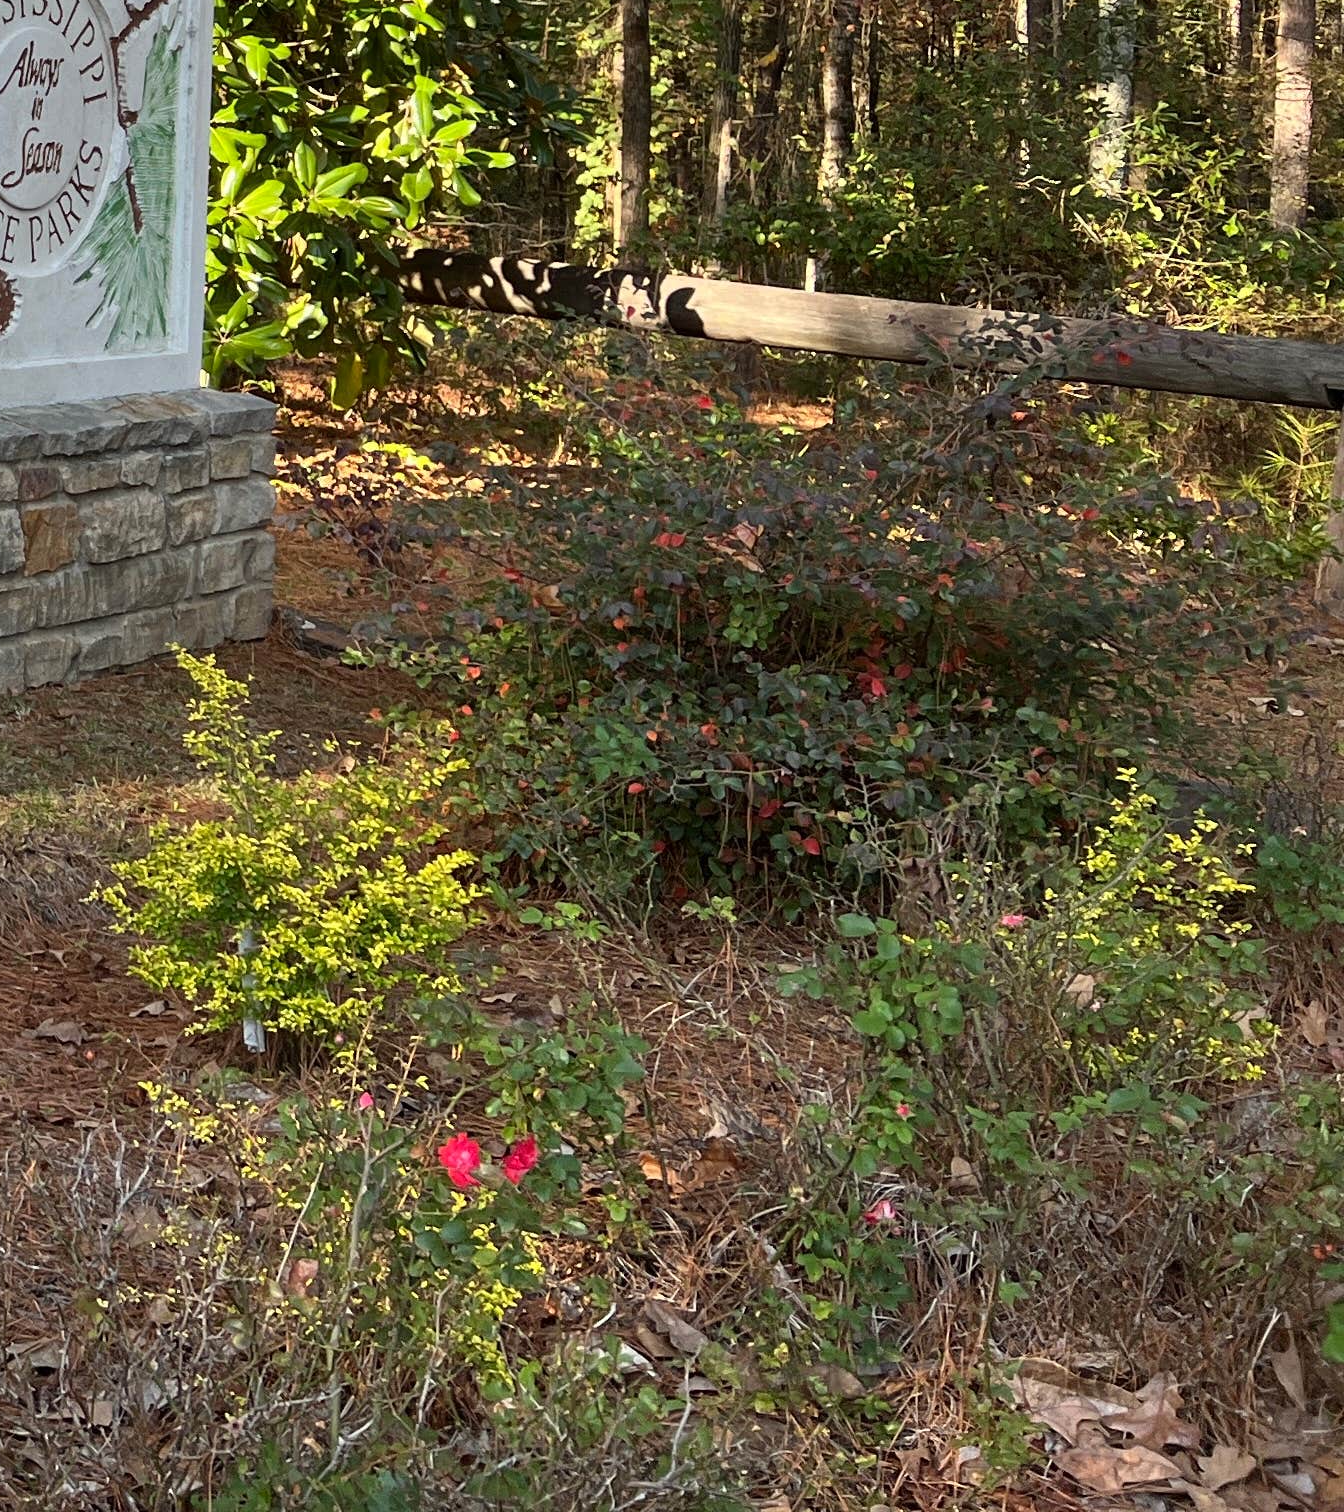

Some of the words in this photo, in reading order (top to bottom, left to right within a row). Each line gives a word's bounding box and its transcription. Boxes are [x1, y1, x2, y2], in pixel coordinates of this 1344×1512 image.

[0, 41, 65, 99] Always
[31, 91, 43, 122] in
[0, 127, 64, 189] Season
[29, 139, 104, 264] PARKS
